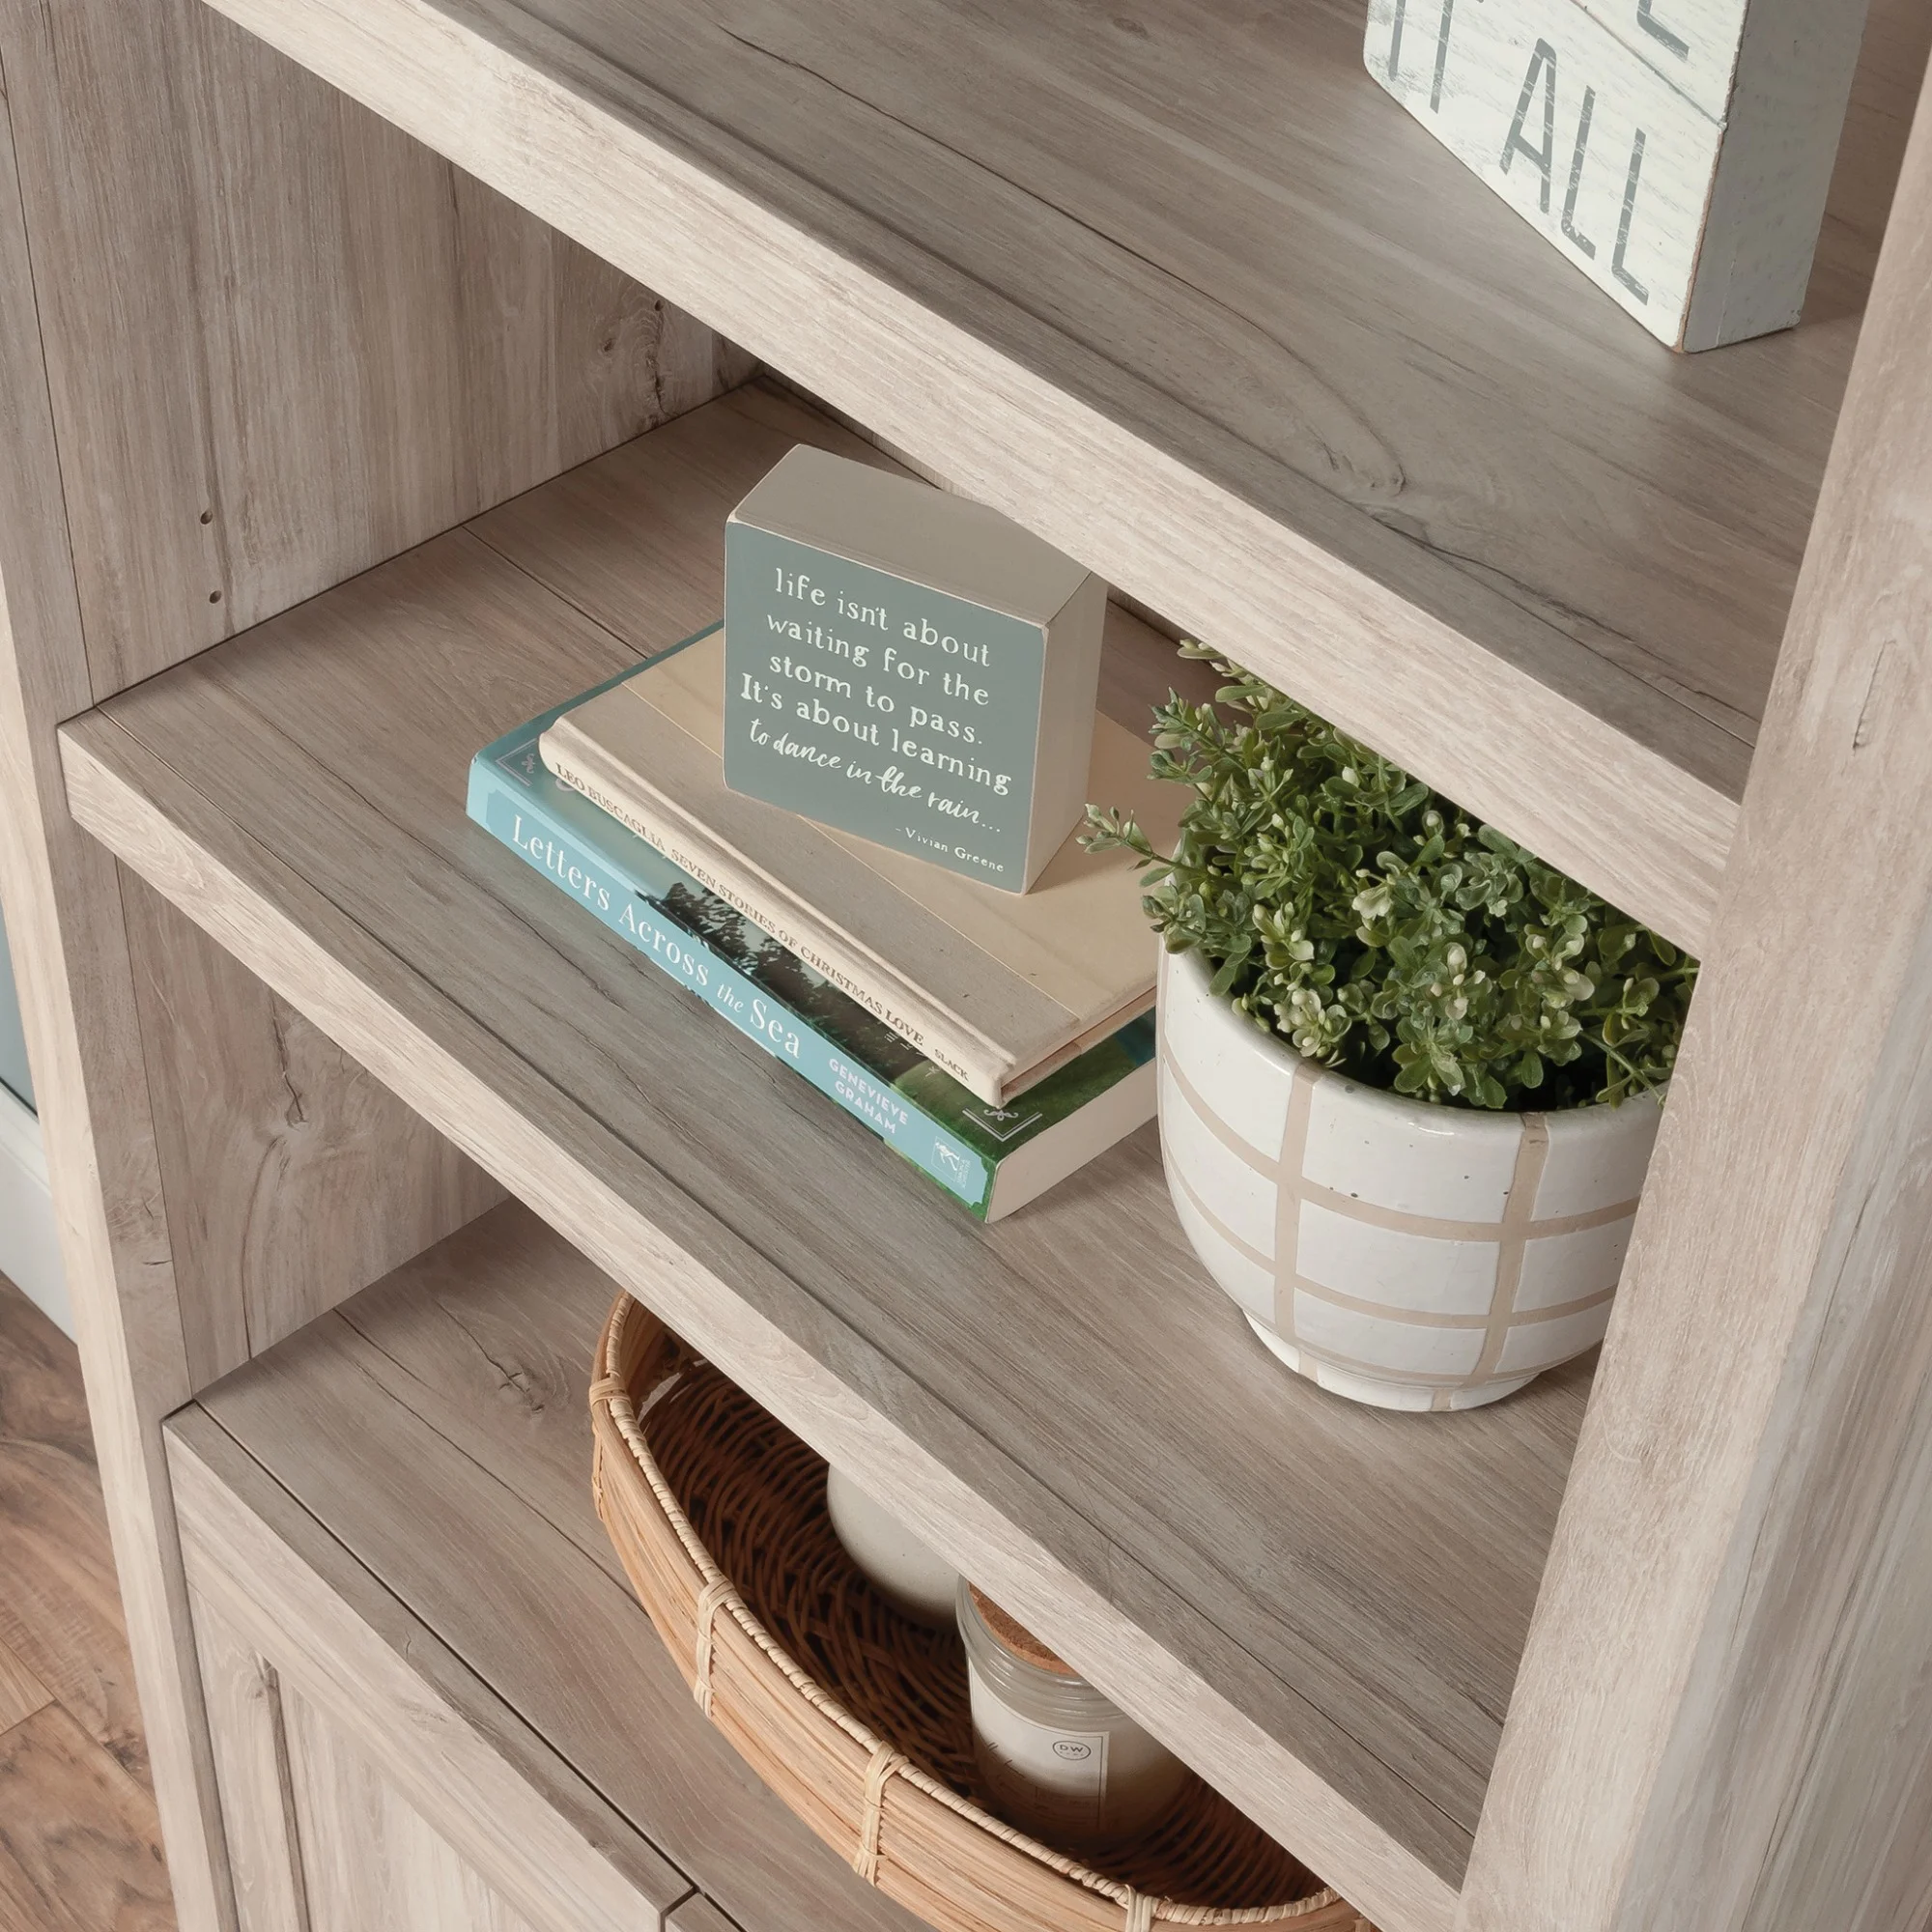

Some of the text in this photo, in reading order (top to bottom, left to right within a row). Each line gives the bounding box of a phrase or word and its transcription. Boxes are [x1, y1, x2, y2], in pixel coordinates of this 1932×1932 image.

[1499, 38, 1649, 305] ALL
[767, 614, 989, 705] waiting for the
[776, 567, 990, 667] life isn't about
[741, 673, 1011, 796] It's about learning
[769, 655, 982, 745] storm to pass.
[750, 718, 1001, 833] to dance in the rain...
[905, 827, 948, 852] Vivian
[954, 846, 1004, 872] Greene
[512, 814, 611, 911] Letters
[618, 904, 709, 986] Across
[717, 984, 745, 1013] the
[750, 998, 801, 1059] Sea
[555, 762, 584, 790] LEO
[588, 784, 666, 852] BUSCAGLIA
[671, 849, 717, 888] SEVEN
[719, 884, 776, 934] STORIES
[779, 928, 799, 951] OF
[801, 947, 883, 1015] CHRISTMAS
[886, 1009, 924, 1046] LOVE
[934, 1049, 969, 1082] SLACK
[828, 1058, 908, 1125] GENEVIEVE
[835, 1081, 896, 1135] GRAHAM
[1060, 1744, 1084, 1753] DW
